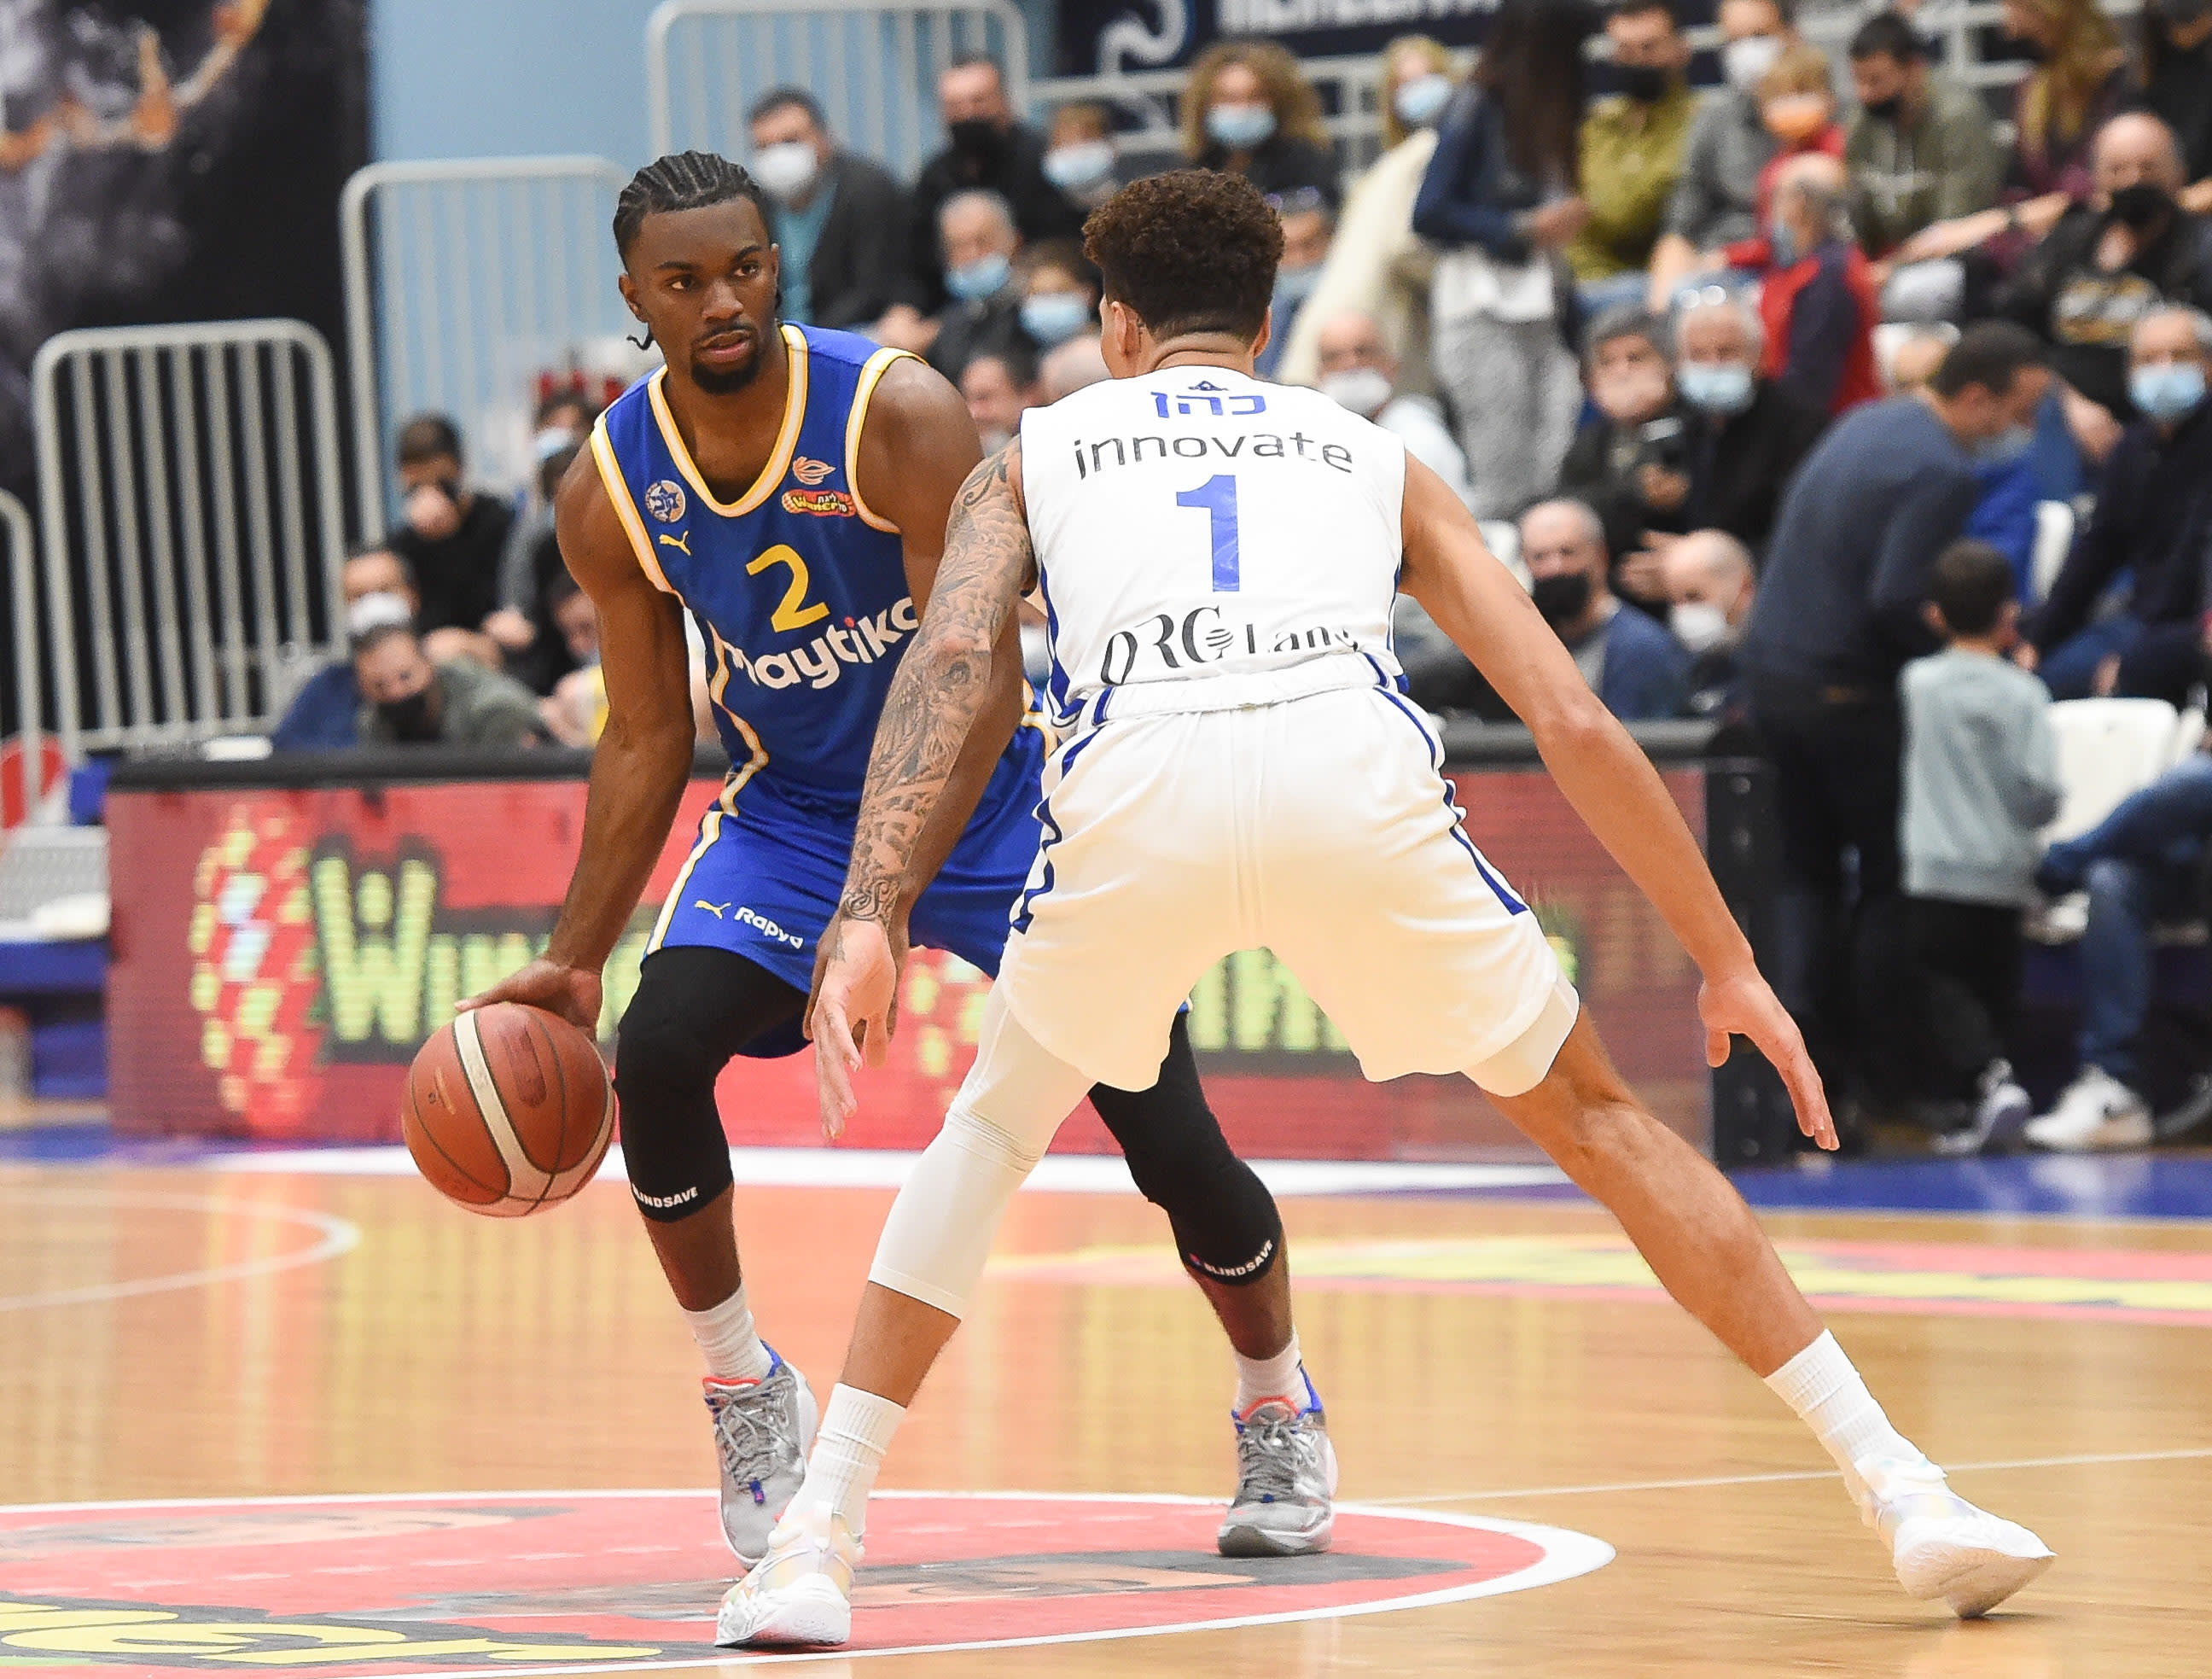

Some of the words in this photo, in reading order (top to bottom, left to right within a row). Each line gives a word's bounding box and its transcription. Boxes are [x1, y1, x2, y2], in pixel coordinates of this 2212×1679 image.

[1074, 431, 1353, 480] innovate
[1176, 475, 1240, 592] 1
[746, 544, 830, 633] 2
